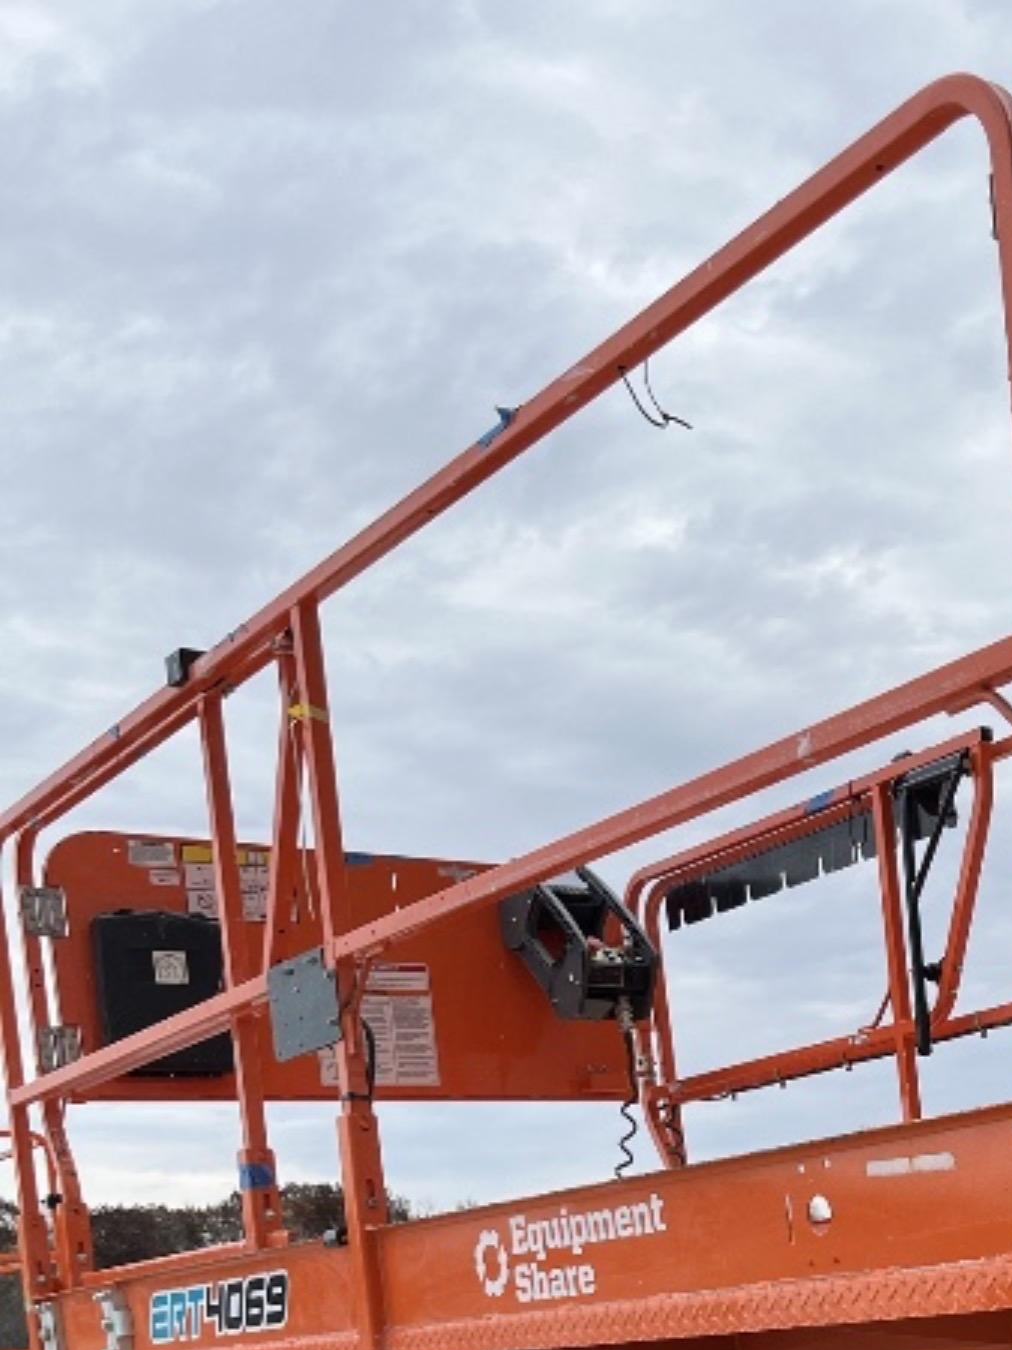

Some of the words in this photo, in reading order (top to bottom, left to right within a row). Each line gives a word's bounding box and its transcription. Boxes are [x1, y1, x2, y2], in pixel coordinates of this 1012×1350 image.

[509, 1193, 667, 1260] Equipment
[150, 1269, 289, 1344] ERT4069
[514, 1262, 597, 1303] Share
